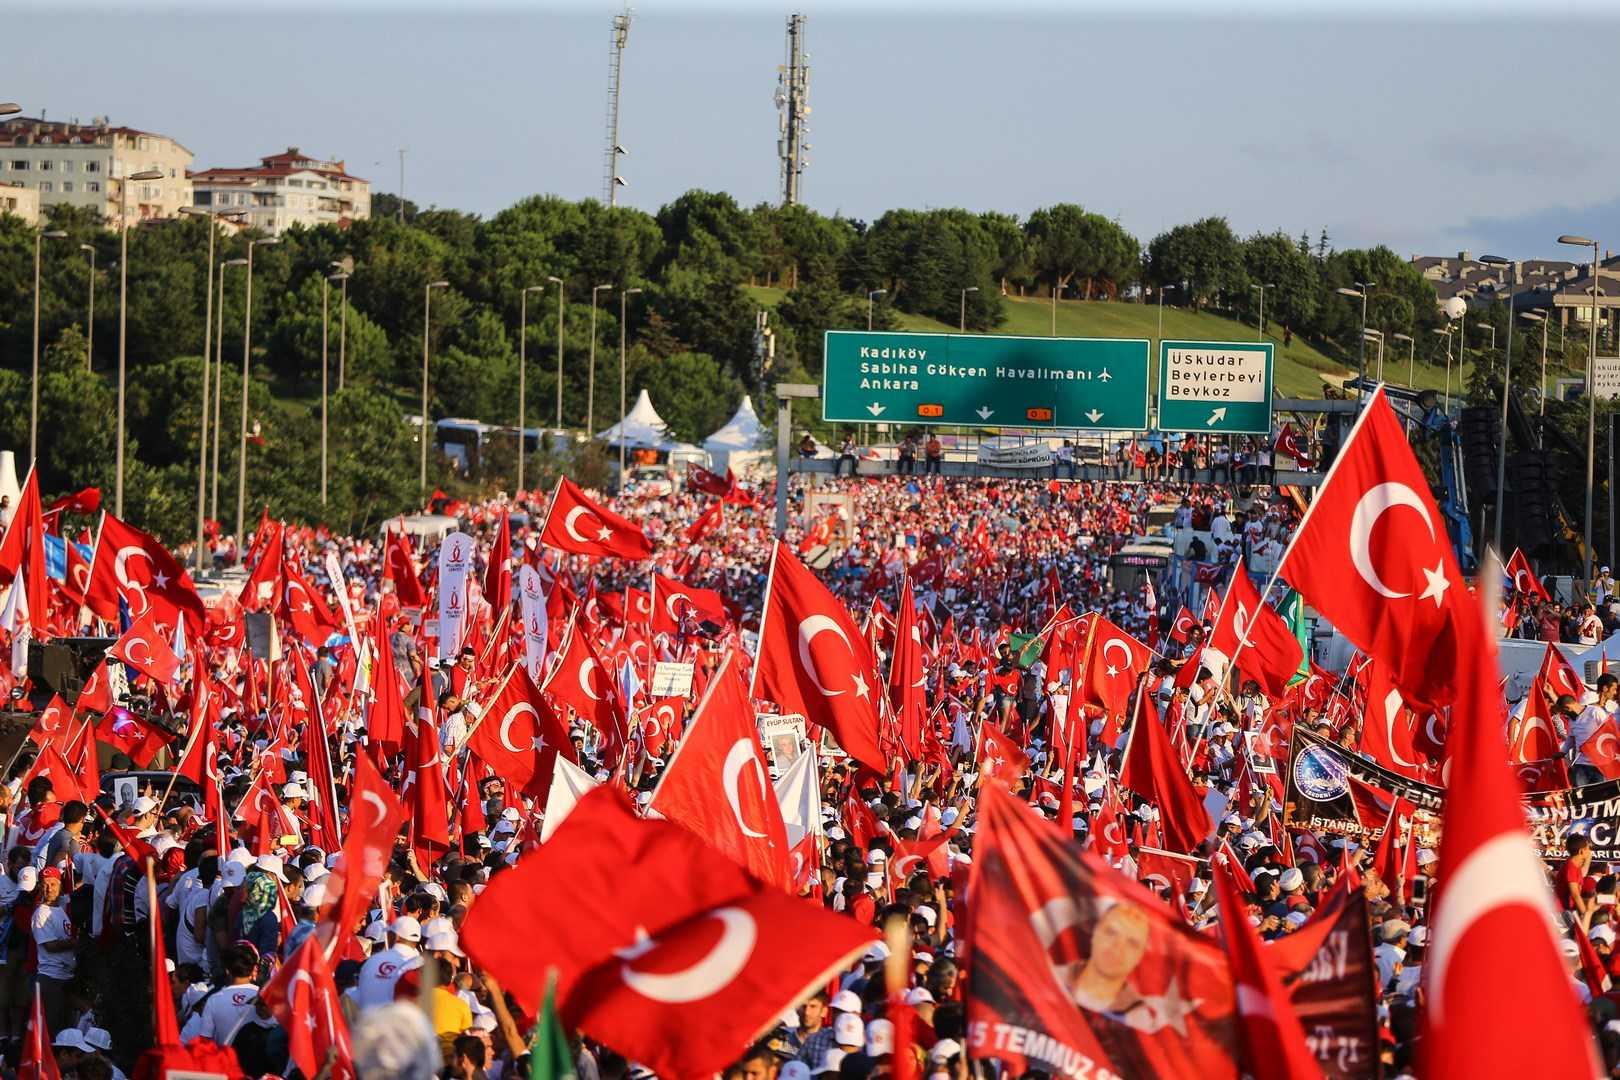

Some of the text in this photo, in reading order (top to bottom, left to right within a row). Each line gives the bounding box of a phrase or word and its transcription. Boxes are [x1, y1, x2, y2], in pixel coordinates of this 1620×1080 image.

[861, 346, 926, 360] Kadıköy
[860, 362, 1092, 380] Sabiha Gökçen Havalimanı
[1171, 369, 1262, 383] Beylerbeyi
[860, 378, 919, 391] Ankara
[1171, 385, 1230, 397] Beykoz
[782, 716, 804, 726] SULTAN
[1310, 813, 1371, 836] İSTANBUL
[994, 1024, 1094, 1080] TEMMUZ
